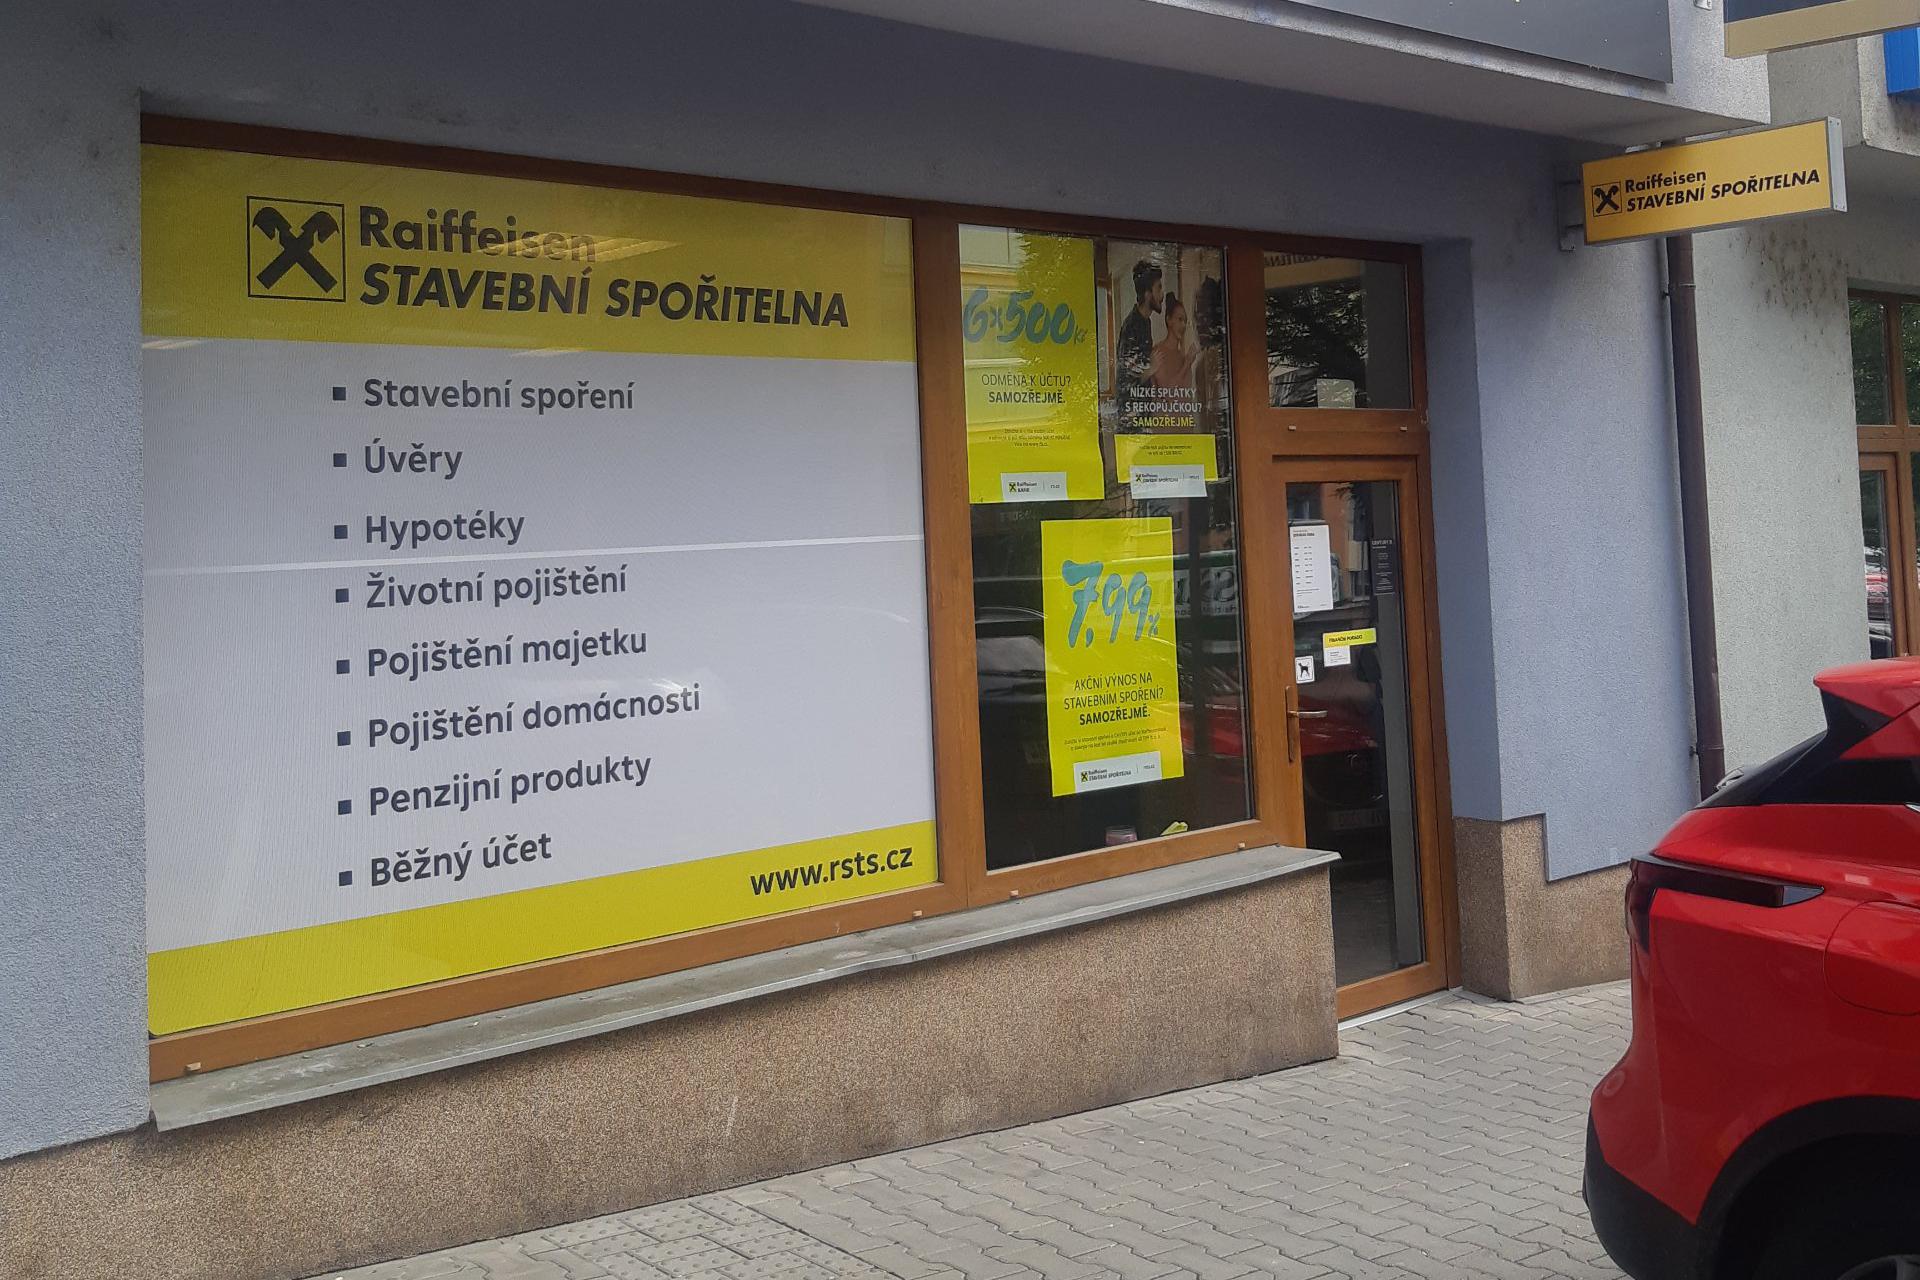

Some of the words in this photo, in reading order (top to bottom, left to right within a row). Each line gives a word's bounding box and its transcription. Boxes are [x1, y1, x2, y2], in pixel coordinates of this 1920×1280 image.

[1625, 169, 1707, 194] Raiffeisen
[1626, 183, 1706, 212] STAVEBNÍ
[1711, 168, 1820, 200] SPOŘITELNA
[359, 206, 597, 263] Raiffeisen
[360, 263, 593, 315] STAVEBNÍ
[605, 274, 850, 328] SPOŘITELNA
[364, 378, 511, 409] Stavební
[520, 381, 635, 415] spoření
[981, 371, 1028, 386] ODMĚNA
[1030, 374, 1037, 386] K
[1039, 371, 1072, 387] ÚČTU?
[988, 388, 1066, 404] SAMOZŘEJMĚ.
[1130, 384, 1156, 398] NÍZKÉ
[1157, 385, 1197, 398] SPLÁTKY
[1125, 401, 1131, 412] S
[1132, 399, 1203, 413] REKOPŮJČKOU?
[1132, 414, 1197, 428] SAMOZŘEJMĚ.
[364, 437, 463, 480] Úvěry
[365, 510, 525, 550] Hypotéky
[366, 571, 484, 608] Životní
[494, 563, 628, 607] pojištění
[368, 635, 512, 681] Pojištění
[522, 628, 647, 666] majetku
[1064, 690, 1118, 710] STAVEBNÍM
[1119, 684, 1164, 704] SPOŘENÍ?
[1074, 674, 1103, 691] AKČNÍ
[1104, 672, 1138, 688] VÝNOS
[1139, 671, 1153, 684] NA
[368, 702, 513, 751] Pojištění
[523, 683, 701, 730] domácnosti
[1079, 704, 1151, 726] SAMOZŘEJMĚ.
[369, 769, 500, 816] Penzijní
[510, 753, 652, 803] produkty
[371, 841, 472, 888] Běžný
[483, 832, 552, 869] účet
[750, 847, 914, 896] www.rsts.cz
